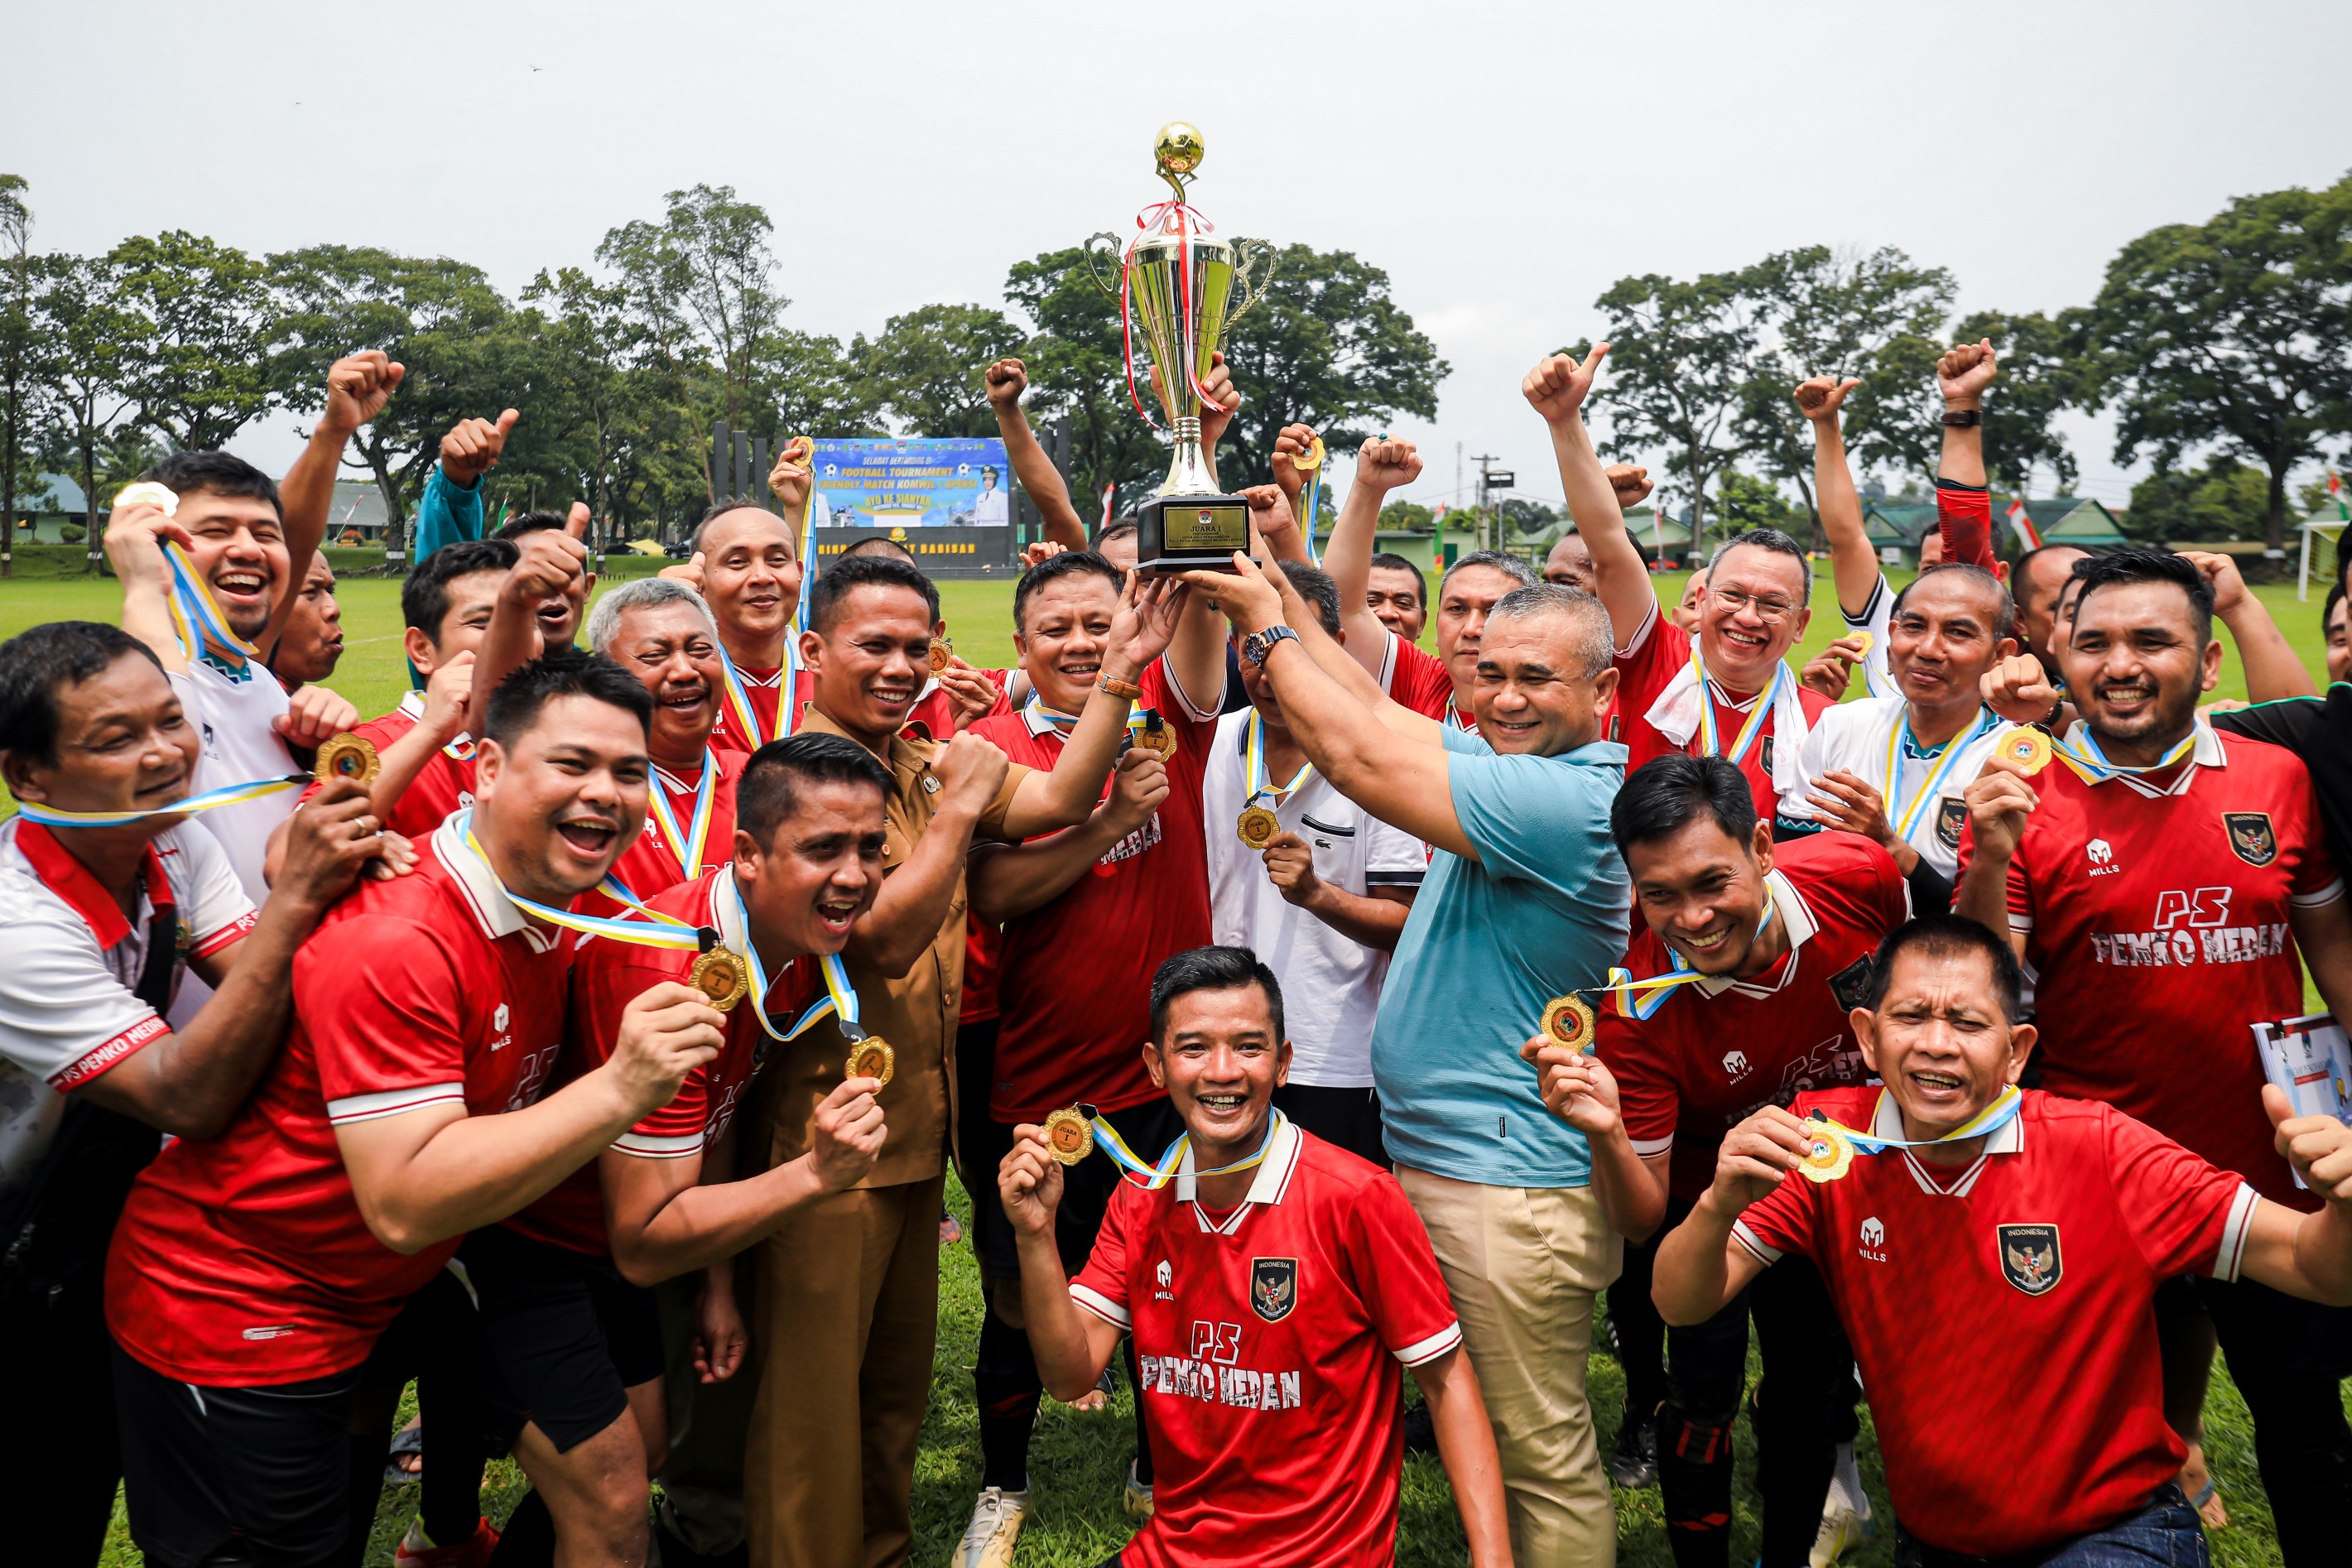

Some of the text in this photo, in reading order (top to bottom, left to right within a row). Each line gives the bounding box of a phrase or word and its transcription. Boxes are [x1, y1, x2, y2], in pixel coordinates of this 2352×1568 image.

[863, 456, 889, 465] SELAMAT
[841, 467, 954, 478] FOOTBALL TOURNAMENT
[818, 480, 860, 489] FRIENDLY
[863, 480, 894, 489] MATCH
[897, 479, 936, 489] KOMWIL
[944, 479, 978, 488] APEKSI
[865, 493, 931, 506] AYO KE SIANTAR
[920, 543, 975, 554] BARISAN
[2088, 864, 2120, 878] MILLS
[2153, 886, 2234, 931] PS
[2090, 922, 2288, 968] PEMKO MEDAN
[61, 1067, 81, 1084] PS
[78, 1038, 127, 1075] PEMKO
[1781, 1034, 1843, 1089] PS
[1729, 1065, 1753, 1086] MILLS
[1059, 1126, 1077, 1137] JUARA
[2007, 1228, 2050, 1237] INDONESIA
[1859, 1248, 1888, 1263] MILLS
[1258, 1261, 1290, 1269] INDONESIA
[1190, 1320, 1242, 1366] PS
[1141, 1354, 1301, 1411] PEMKO MEDAN
